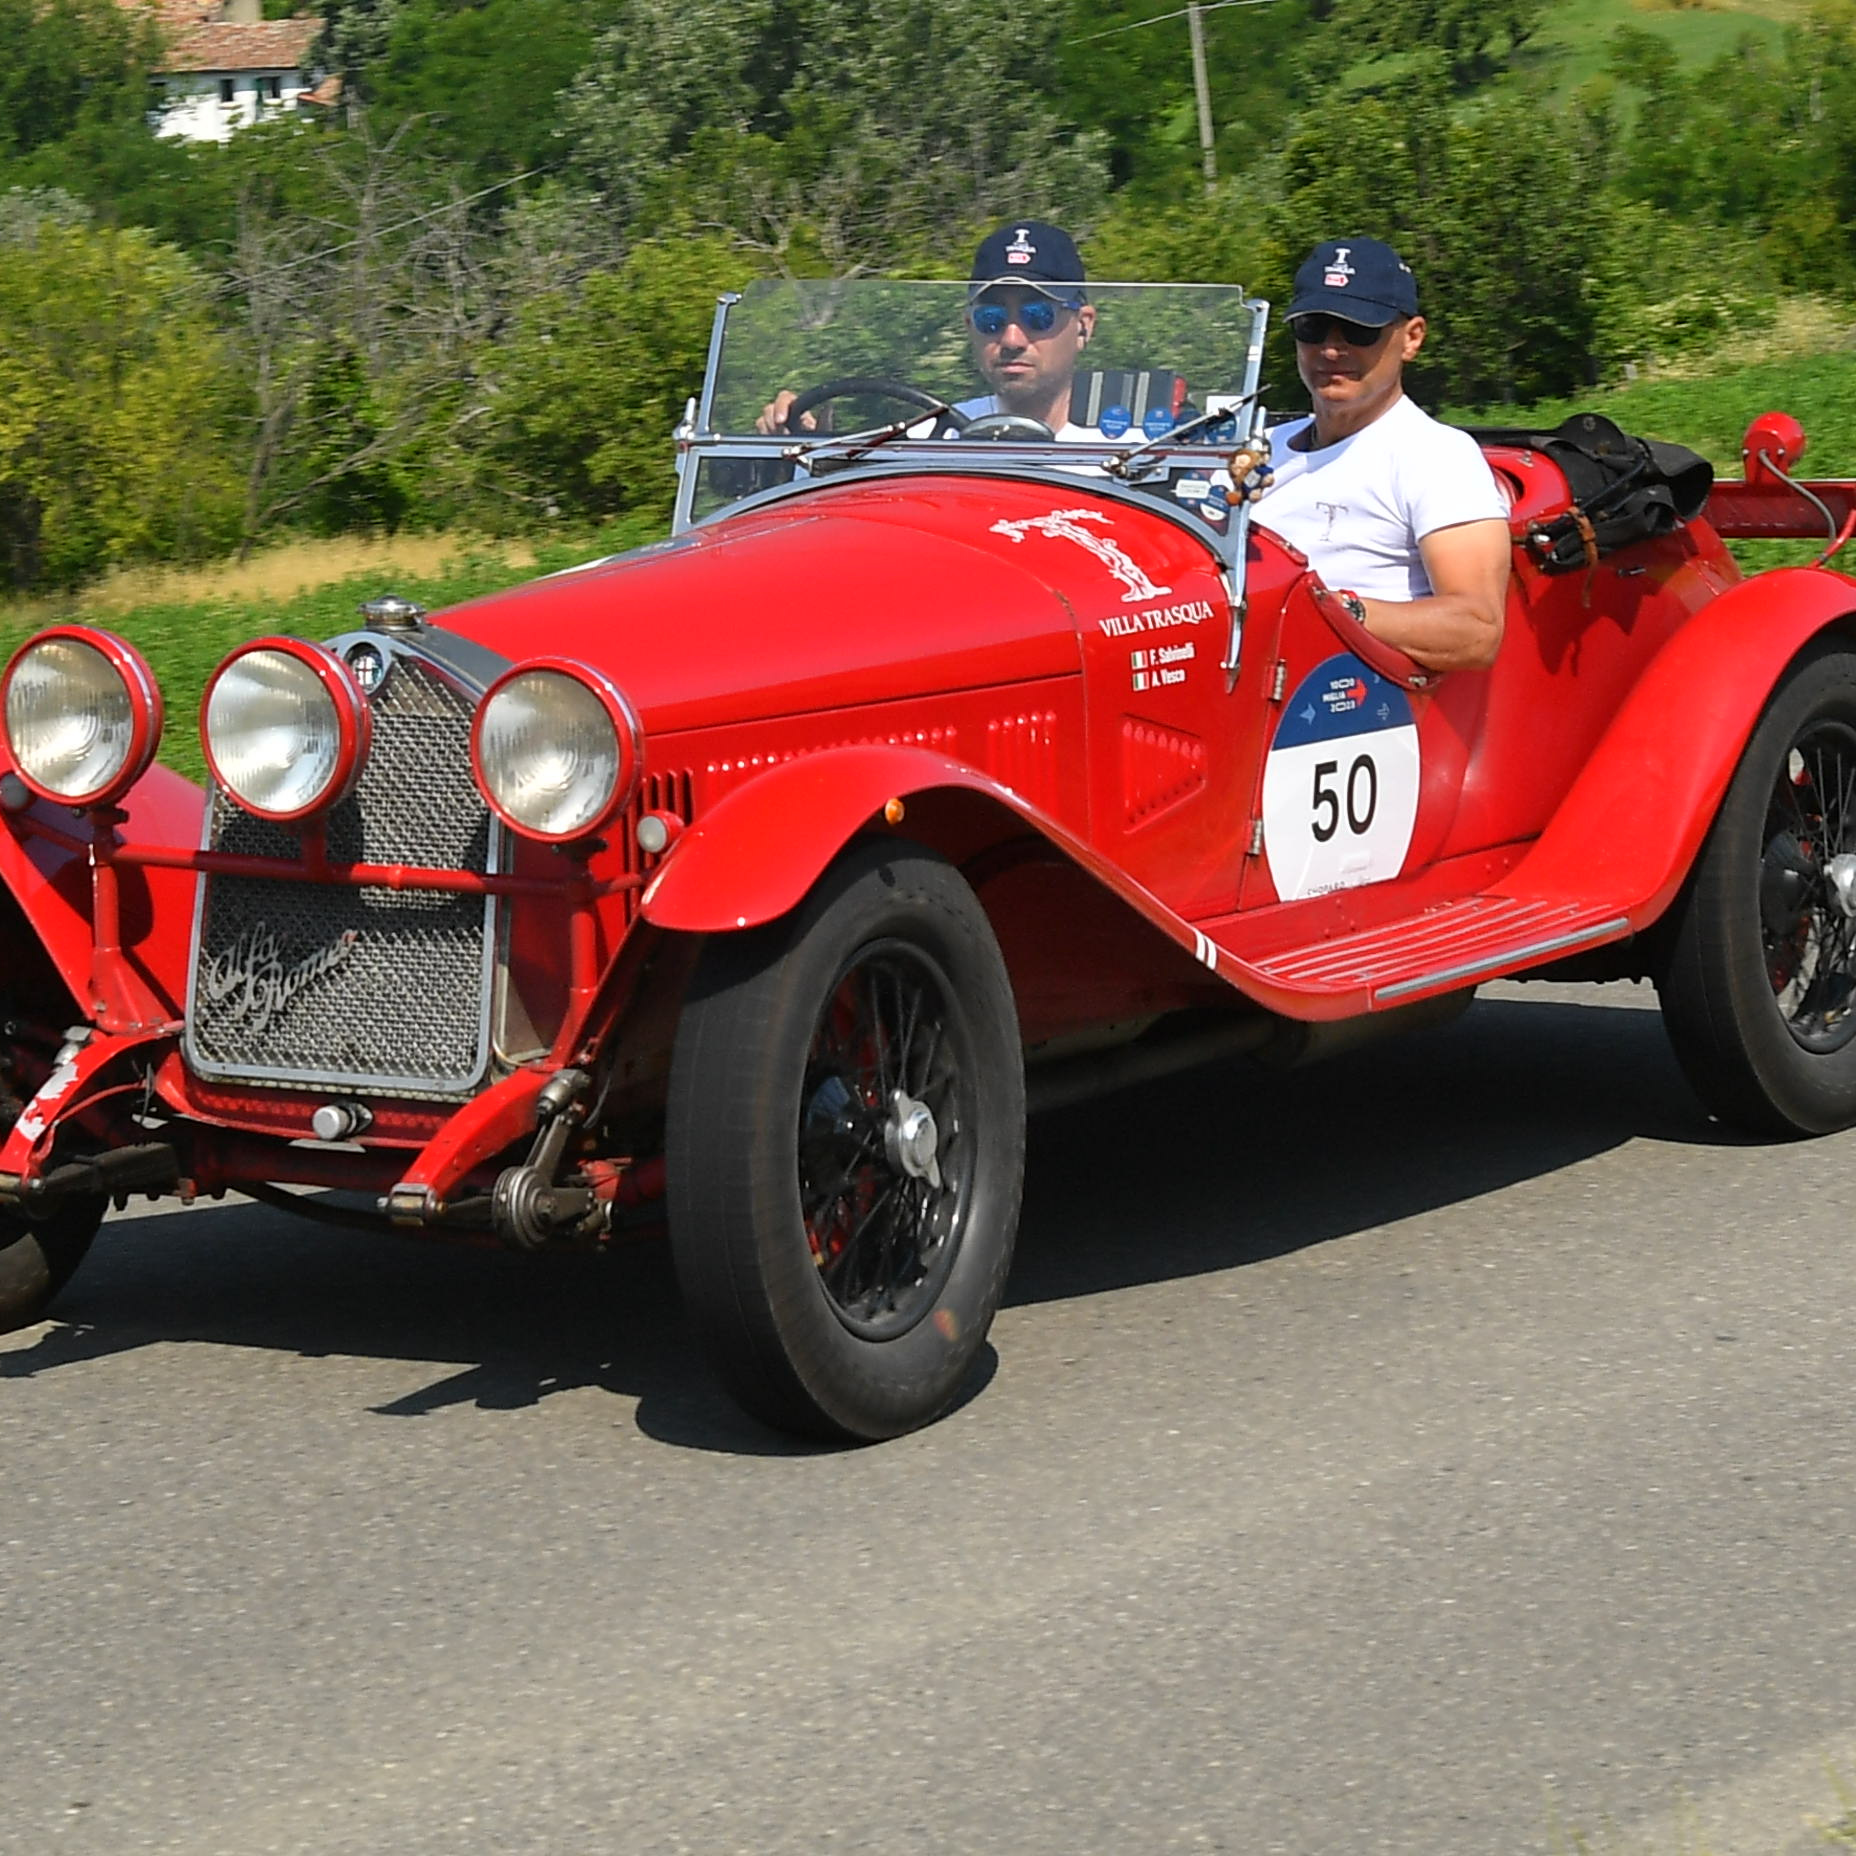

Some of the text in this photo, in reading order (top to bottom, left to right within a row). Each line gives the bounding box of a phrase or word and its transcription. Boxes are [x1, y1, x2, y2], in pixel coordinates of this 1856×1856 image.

[1098, 600, 1214, 637] VILLA TRASQUA
[1149, 648, 1160, 666] F.
[1311, 753, 1377, 843] 50
[250, 929, 358, 1032] Romeo
